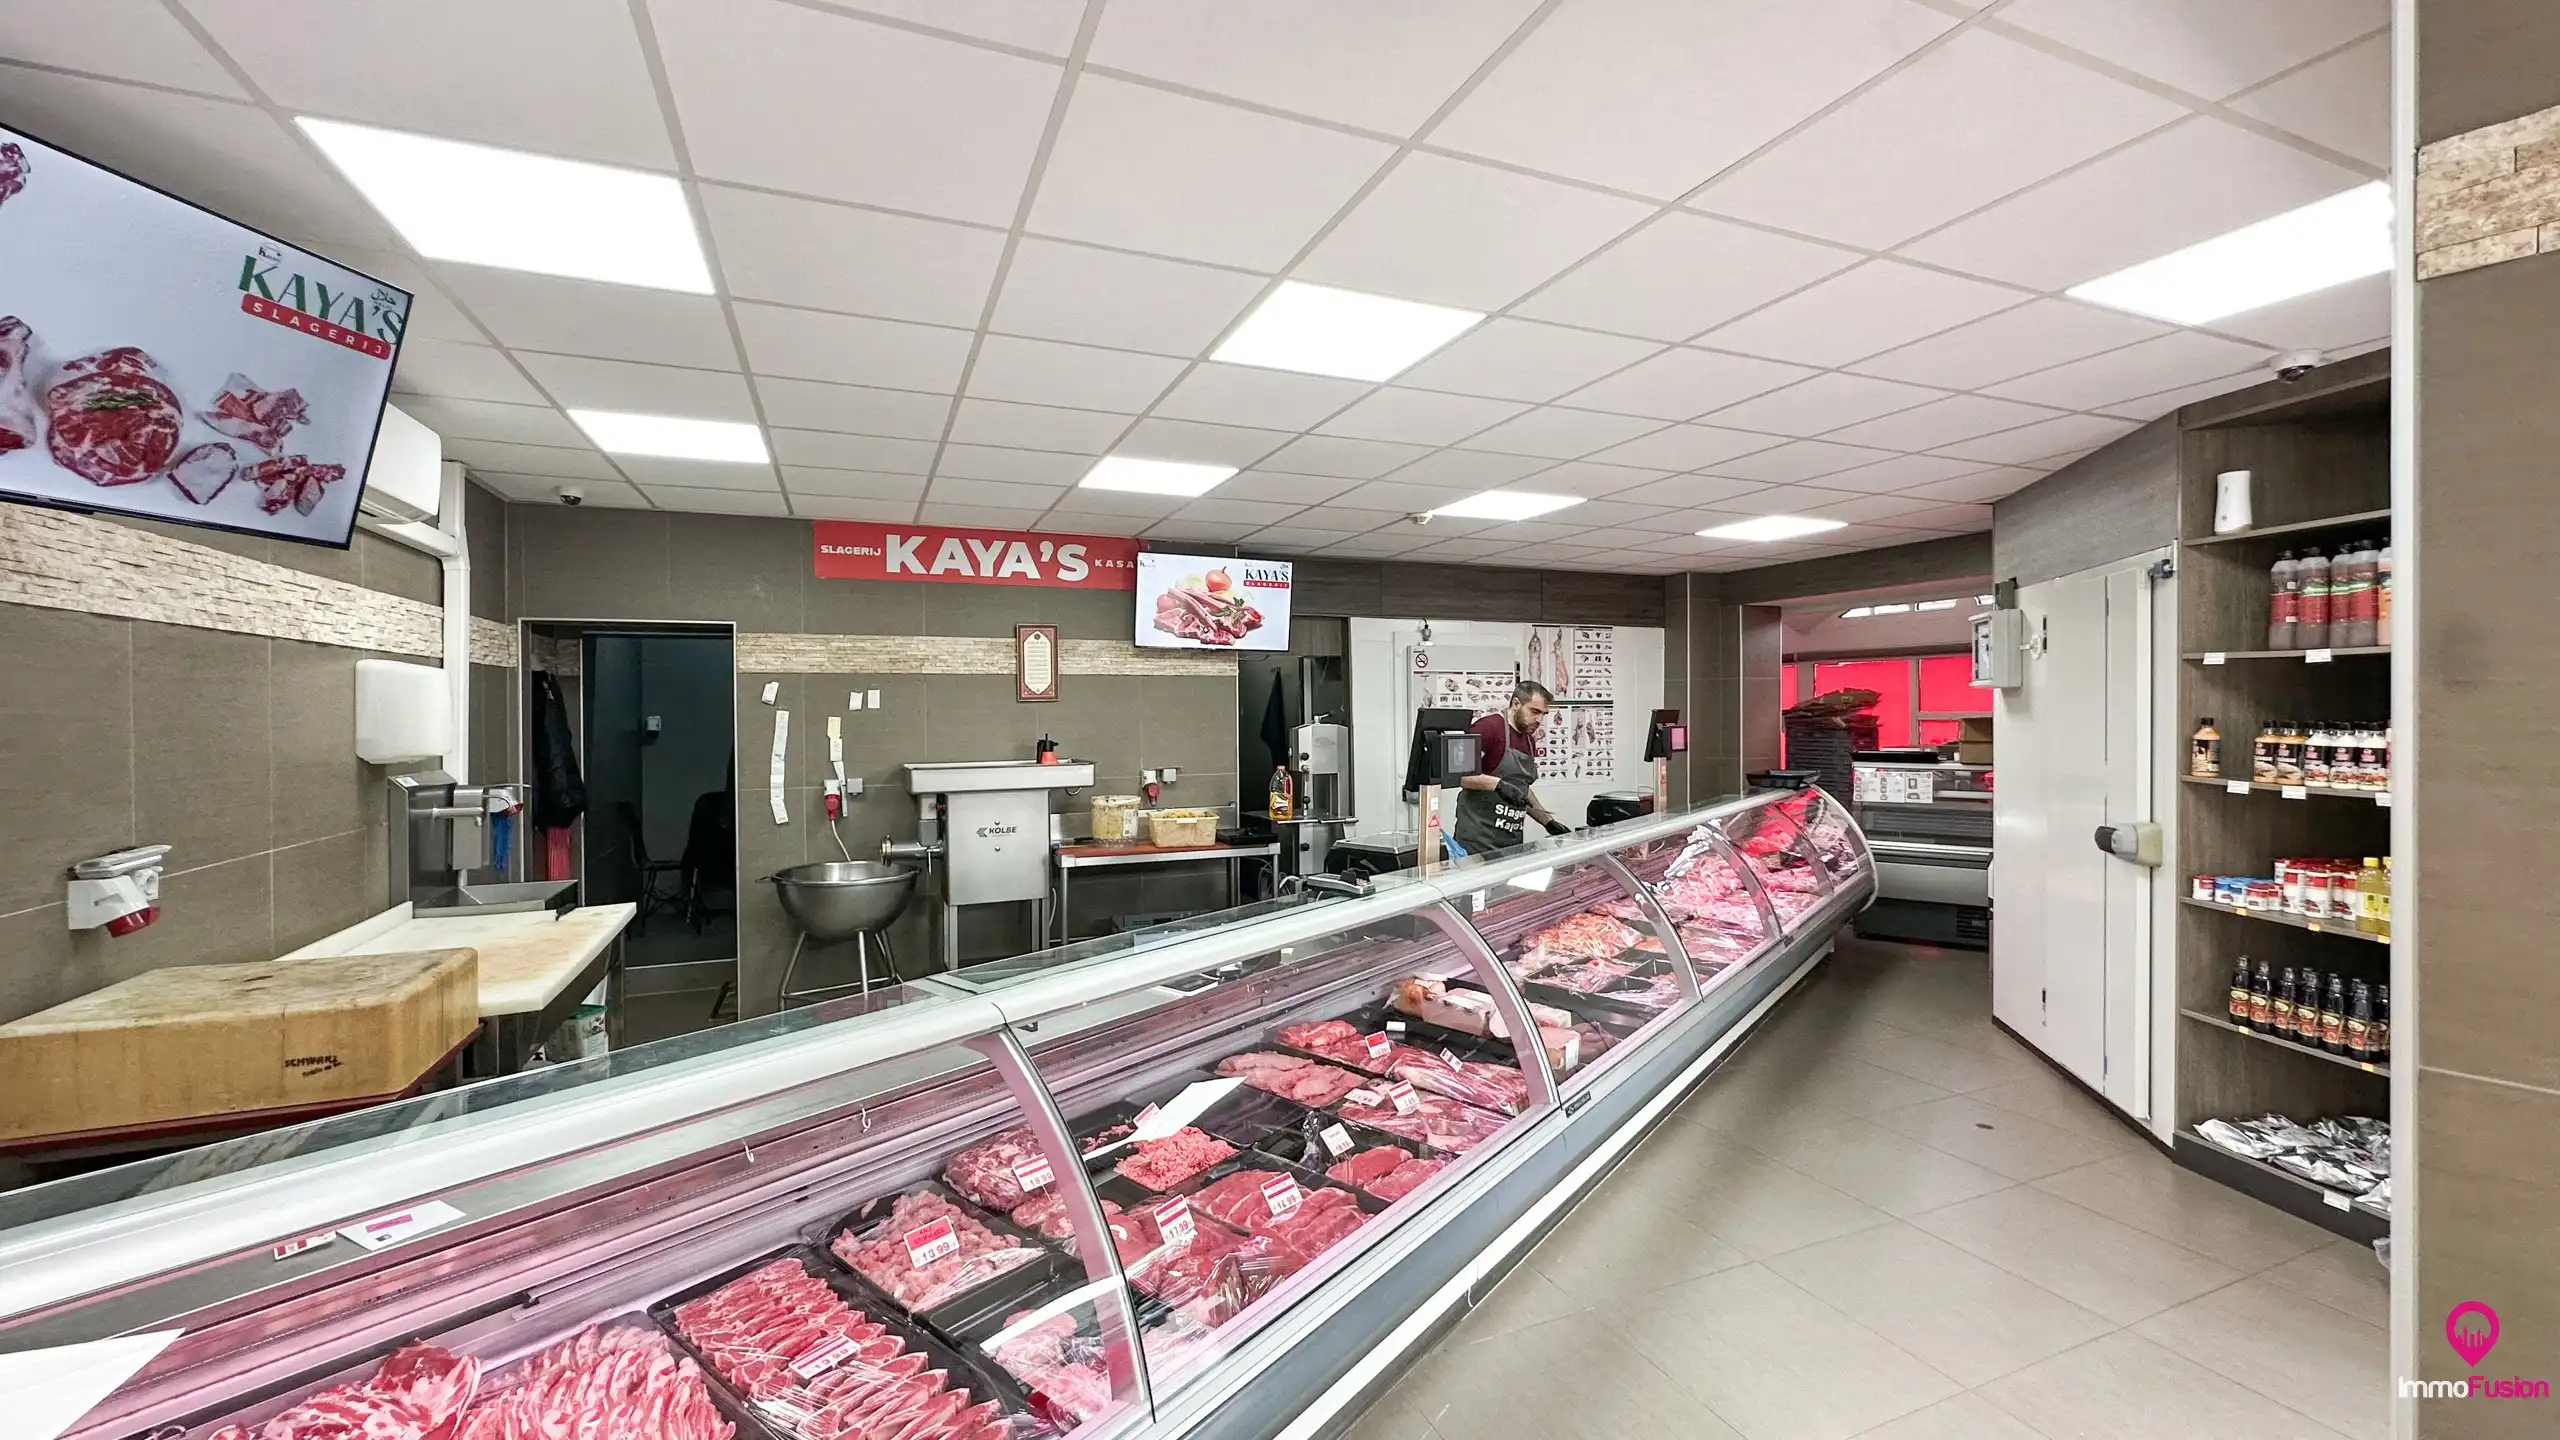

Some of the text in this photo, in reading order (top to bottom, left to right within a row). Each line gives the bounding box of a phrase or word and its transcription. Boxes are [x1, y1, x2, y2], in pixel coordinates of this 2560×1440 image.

[239, 254, 403, 345] KAYA'S
[253, 302, 382, 355] SLAGERIJ
[820, 545, 882, 556] SLAGERIJ
[886, 533, 1089, 581] KAYA'S
[989, 826, 1017, 834] KOLBE
